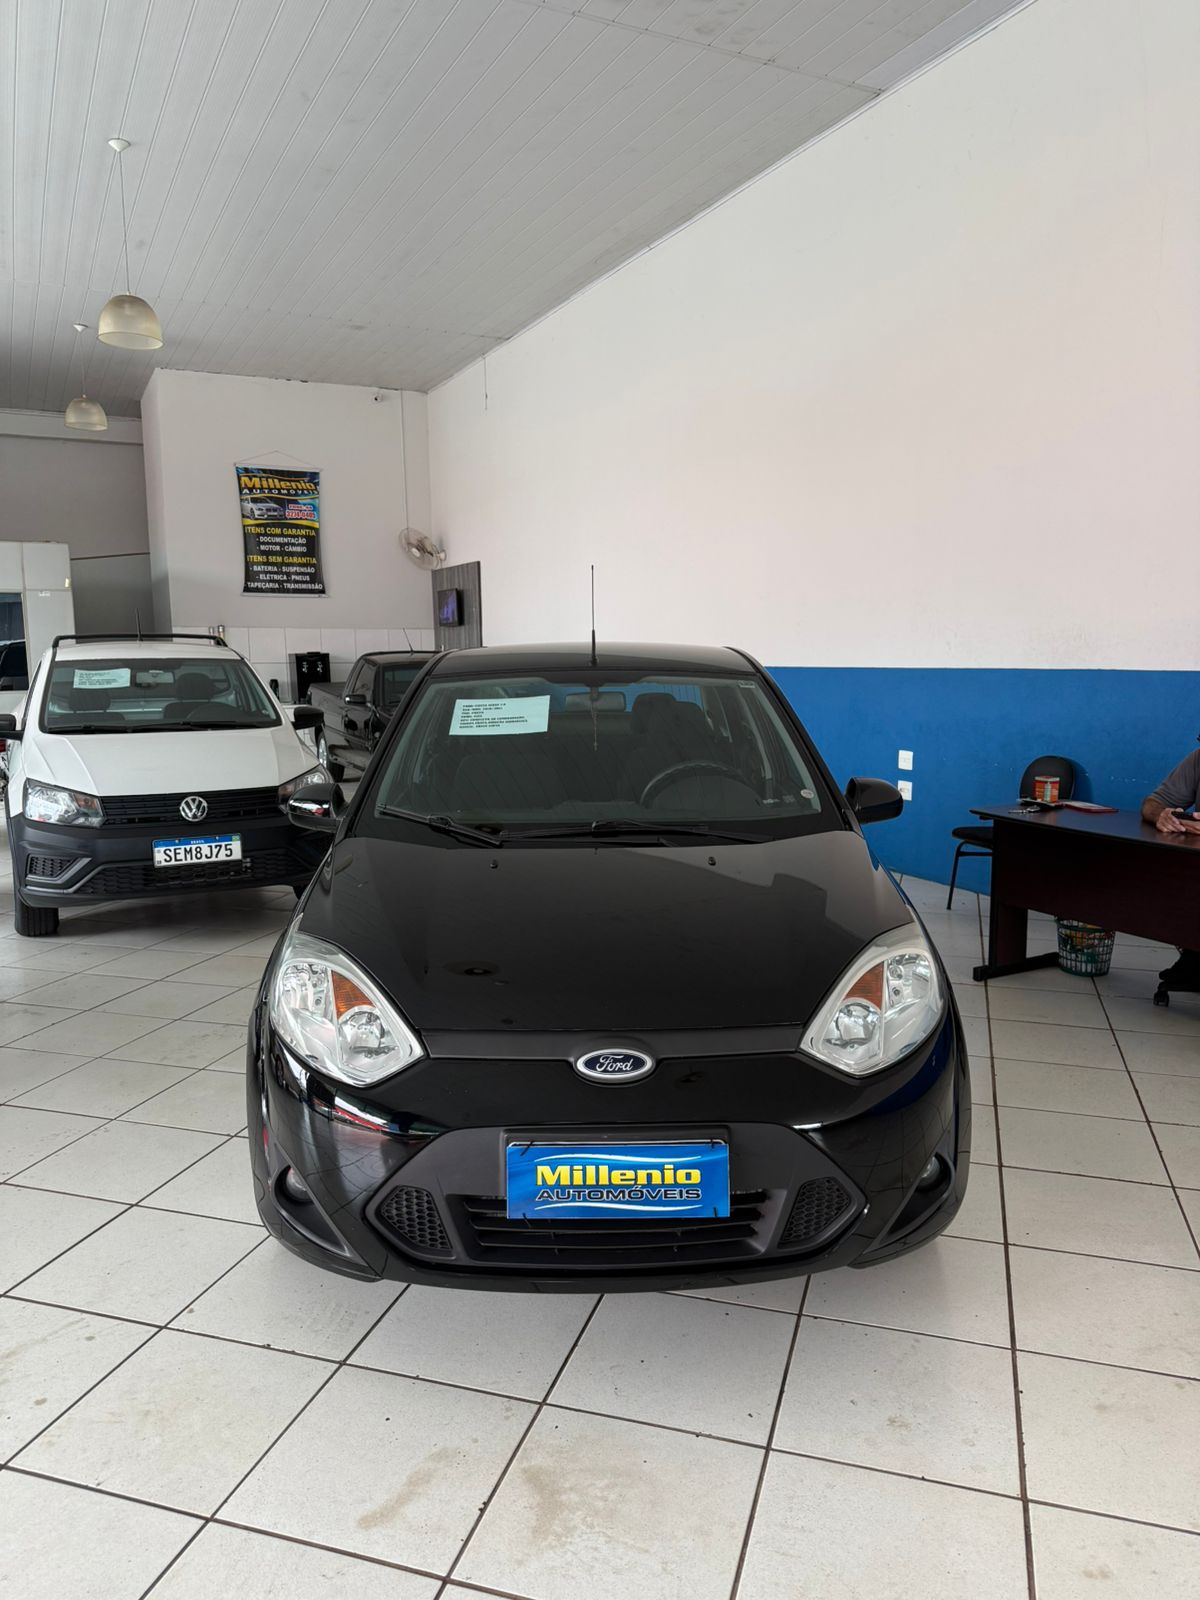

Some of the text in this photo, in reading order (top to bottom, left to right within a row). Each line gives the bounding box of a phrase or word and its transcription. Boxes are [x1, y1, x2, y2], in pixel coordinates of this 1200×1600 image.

[240, 476, 316, 490] Millenio
[245, 526, 316, 536] ITENS COM GARANTIA
[259, 536, 307, 544] DOCUMENTAÇÃO
[284, 556, 317, 564] GARANTIA
[163, 843, 233, 863] SEM8J75
[595, 1054, 634, 1073] Ford
[535, 1164, 702, 1186] Millenio
[535, 1184, 703, 1202] AUTOMÓVEIS
